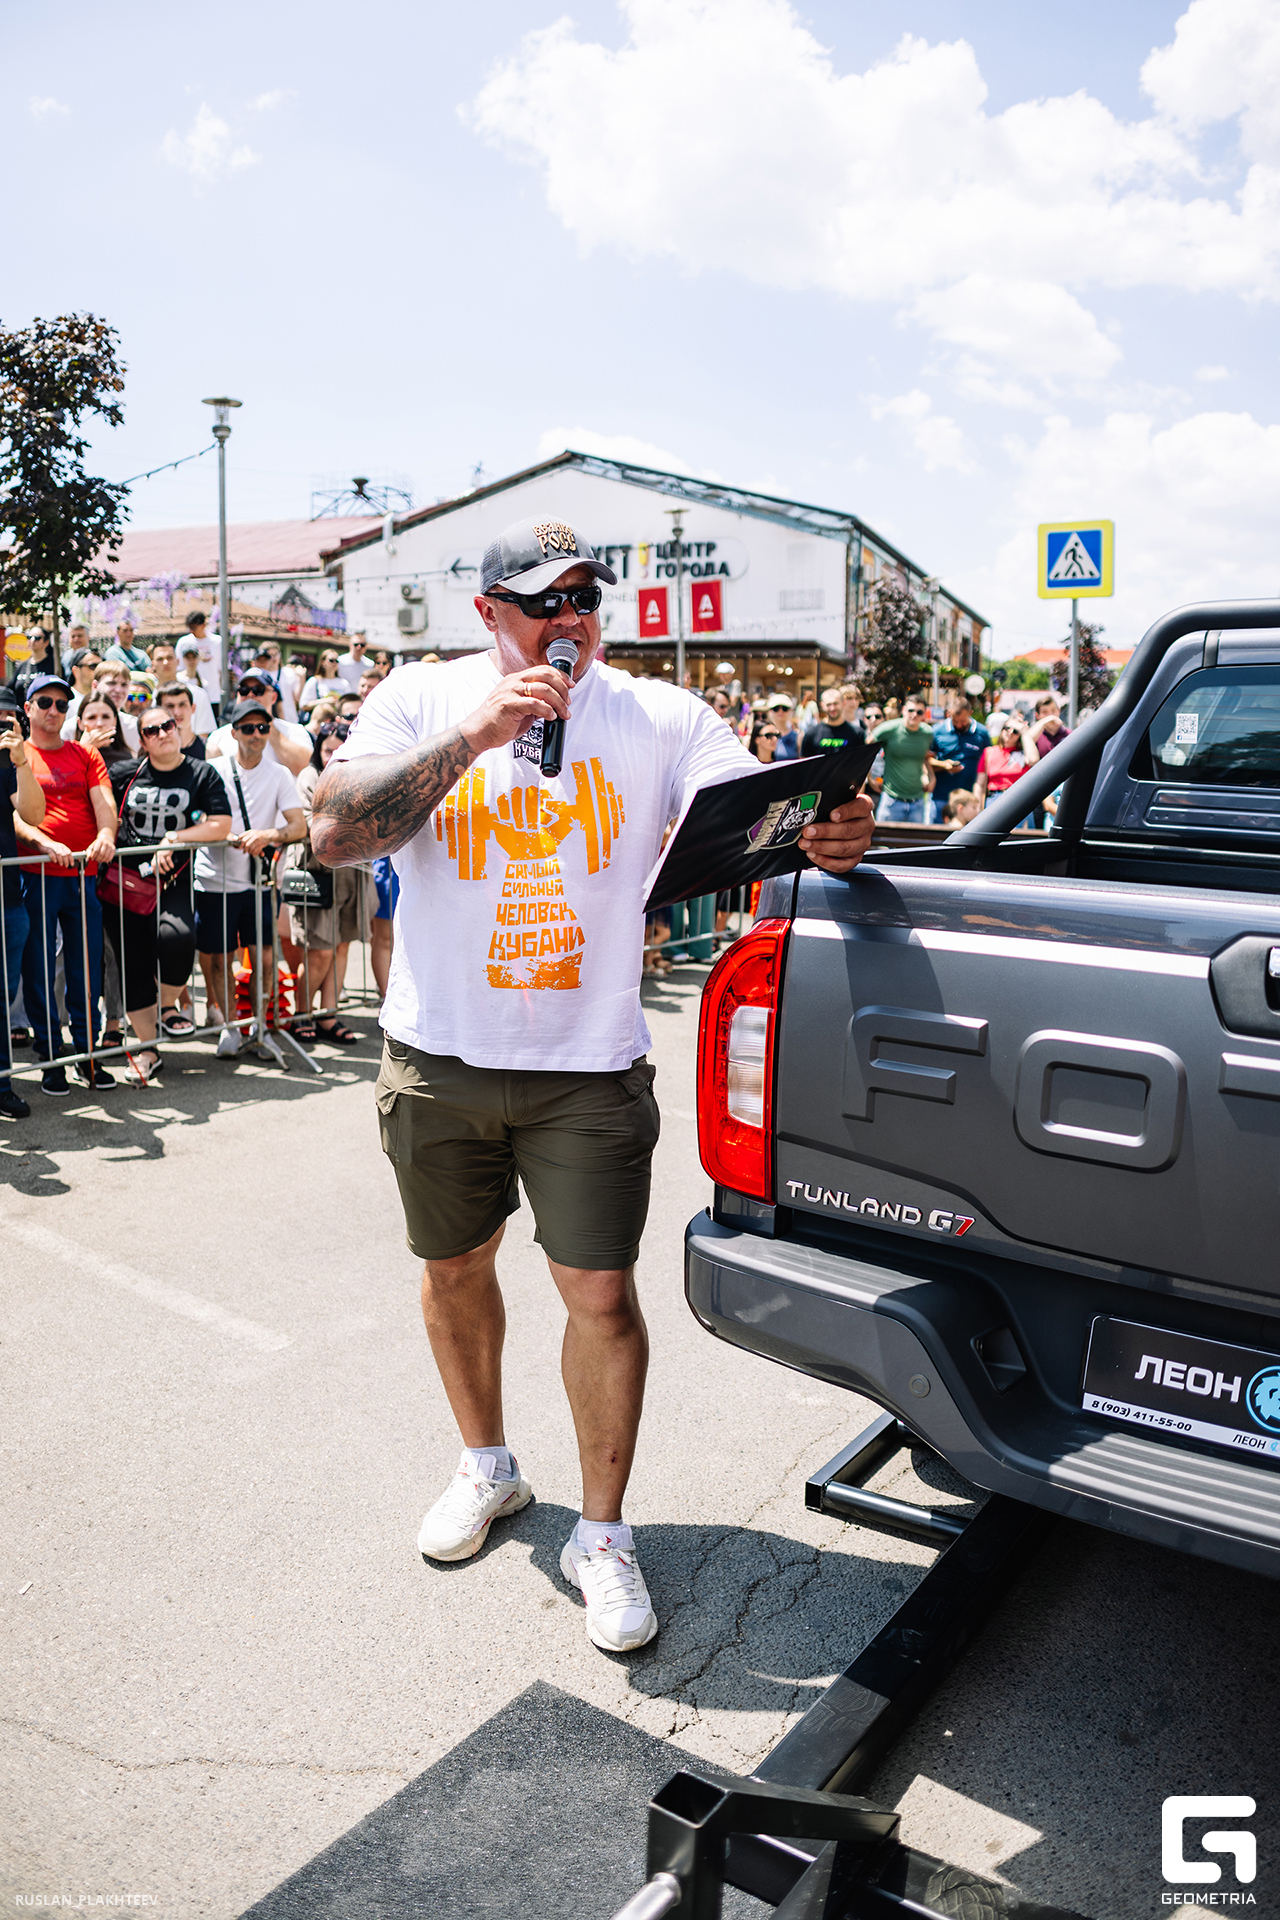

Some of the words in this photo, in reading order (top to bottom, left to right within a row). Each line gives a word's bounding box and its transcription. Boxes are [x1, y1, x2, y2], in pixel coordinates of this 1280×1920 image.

[537, 531, 577, 554] РОСС
[656, 542, 716, 560] ЦЕНТР
[656, 562, 730, 578] ГОРОДА
[515, 742, 541, 759] КУБА
[505, 858, 561, 879] САМЫЙ
[501, 879, 565, 898] СИЛЬНЫЙ
[496, 902, 577, 926] ЧЕЛОВЕК
[488, 926, 586, 962] КУБАНИ
[785, 1179, 923, 1226] TUNLAND
[928, 1209, 976, 1237] G7
[1133, 1354, 1243, 1404] ЛЕОН
[1091, 1400, 1100, 1409] 8
[1101, 1402, 1131, 1418] (903)
[1133, 1410, 1193, 1432] 411-55-00
[1232, 1434, 1267, 1451] ЛЕОН
